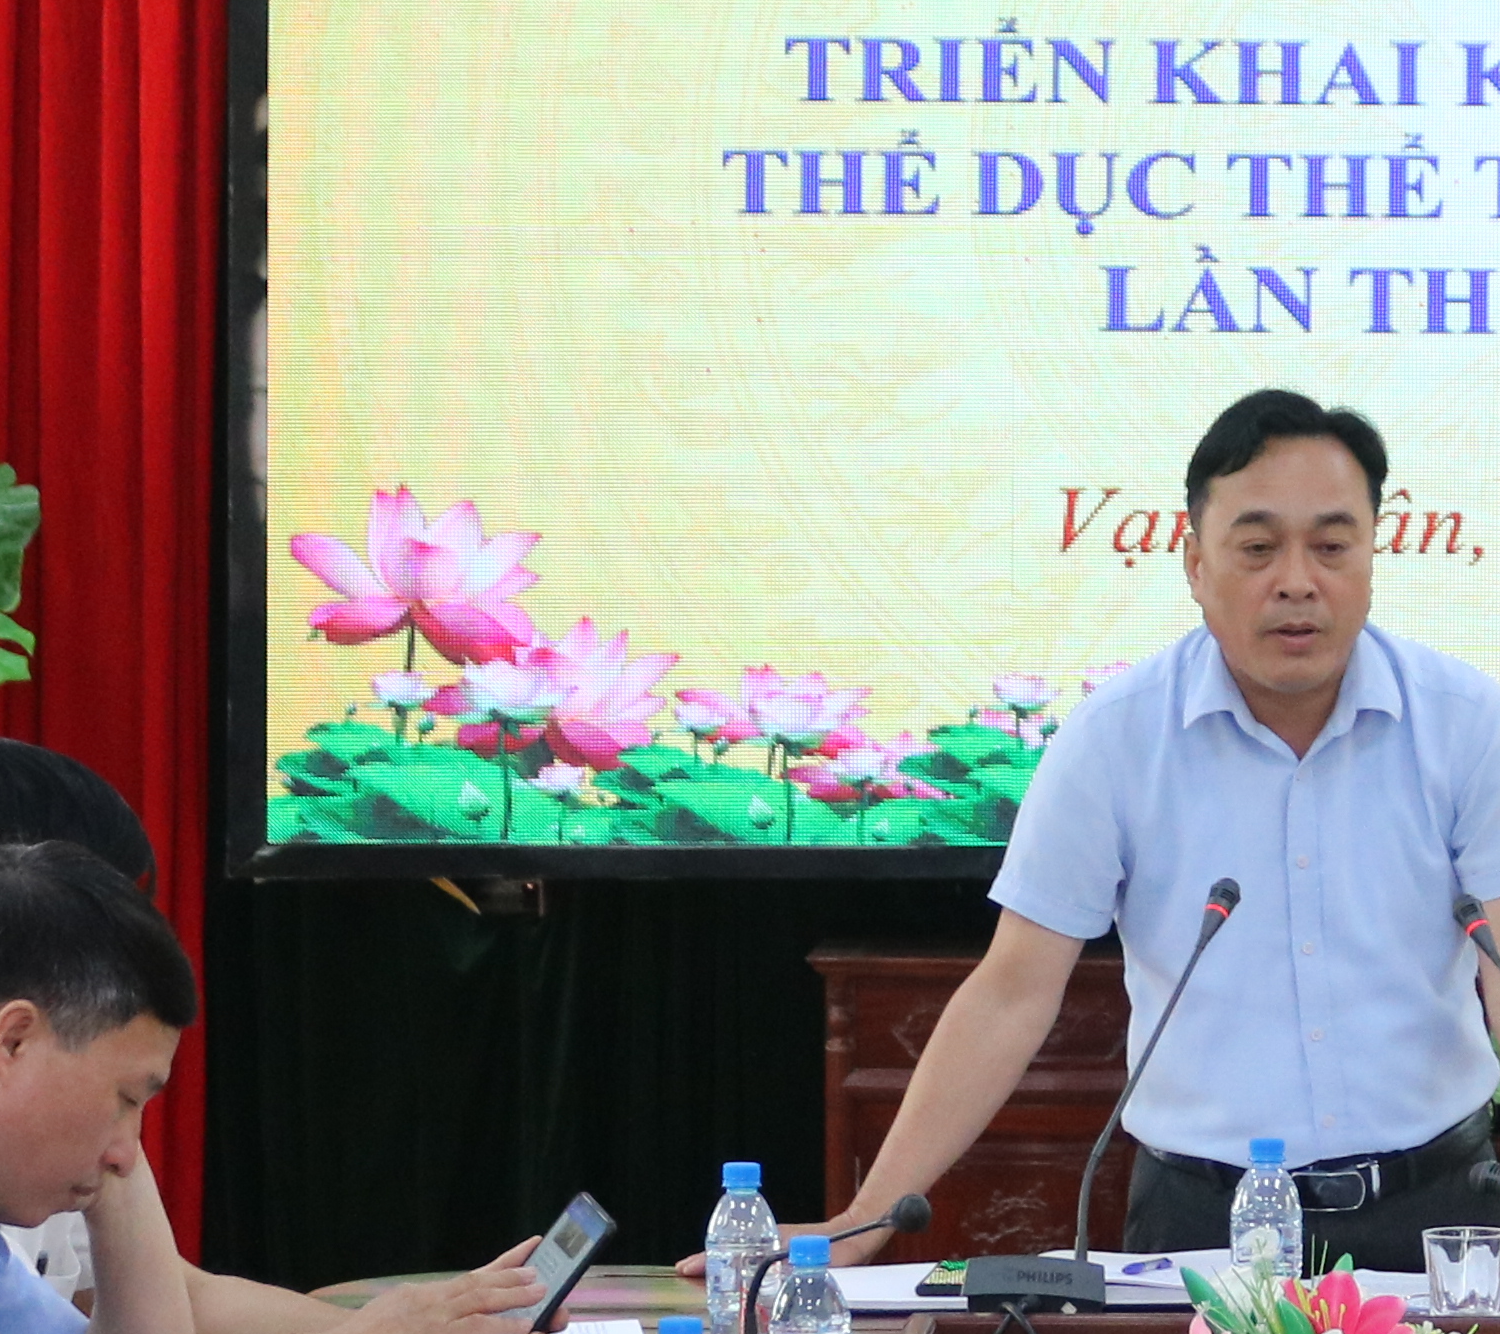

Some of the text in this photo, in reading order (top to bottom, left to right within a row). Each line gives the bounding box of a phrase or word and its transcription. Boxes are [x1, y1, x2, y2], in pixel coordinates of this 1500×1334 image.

[785, 17, 1116, 104] TRIỂN
[1148, 39, 1426, 105] KHAI
[722, 129, 940, 216] THỂ
[972, 149, 1198, 236] DỤC
[1227, 132, 1444, 220] THỂ
[1100, 244, 1318, 334] LẦN
[1017, 1270, 1073, 1285] PHILIPS
